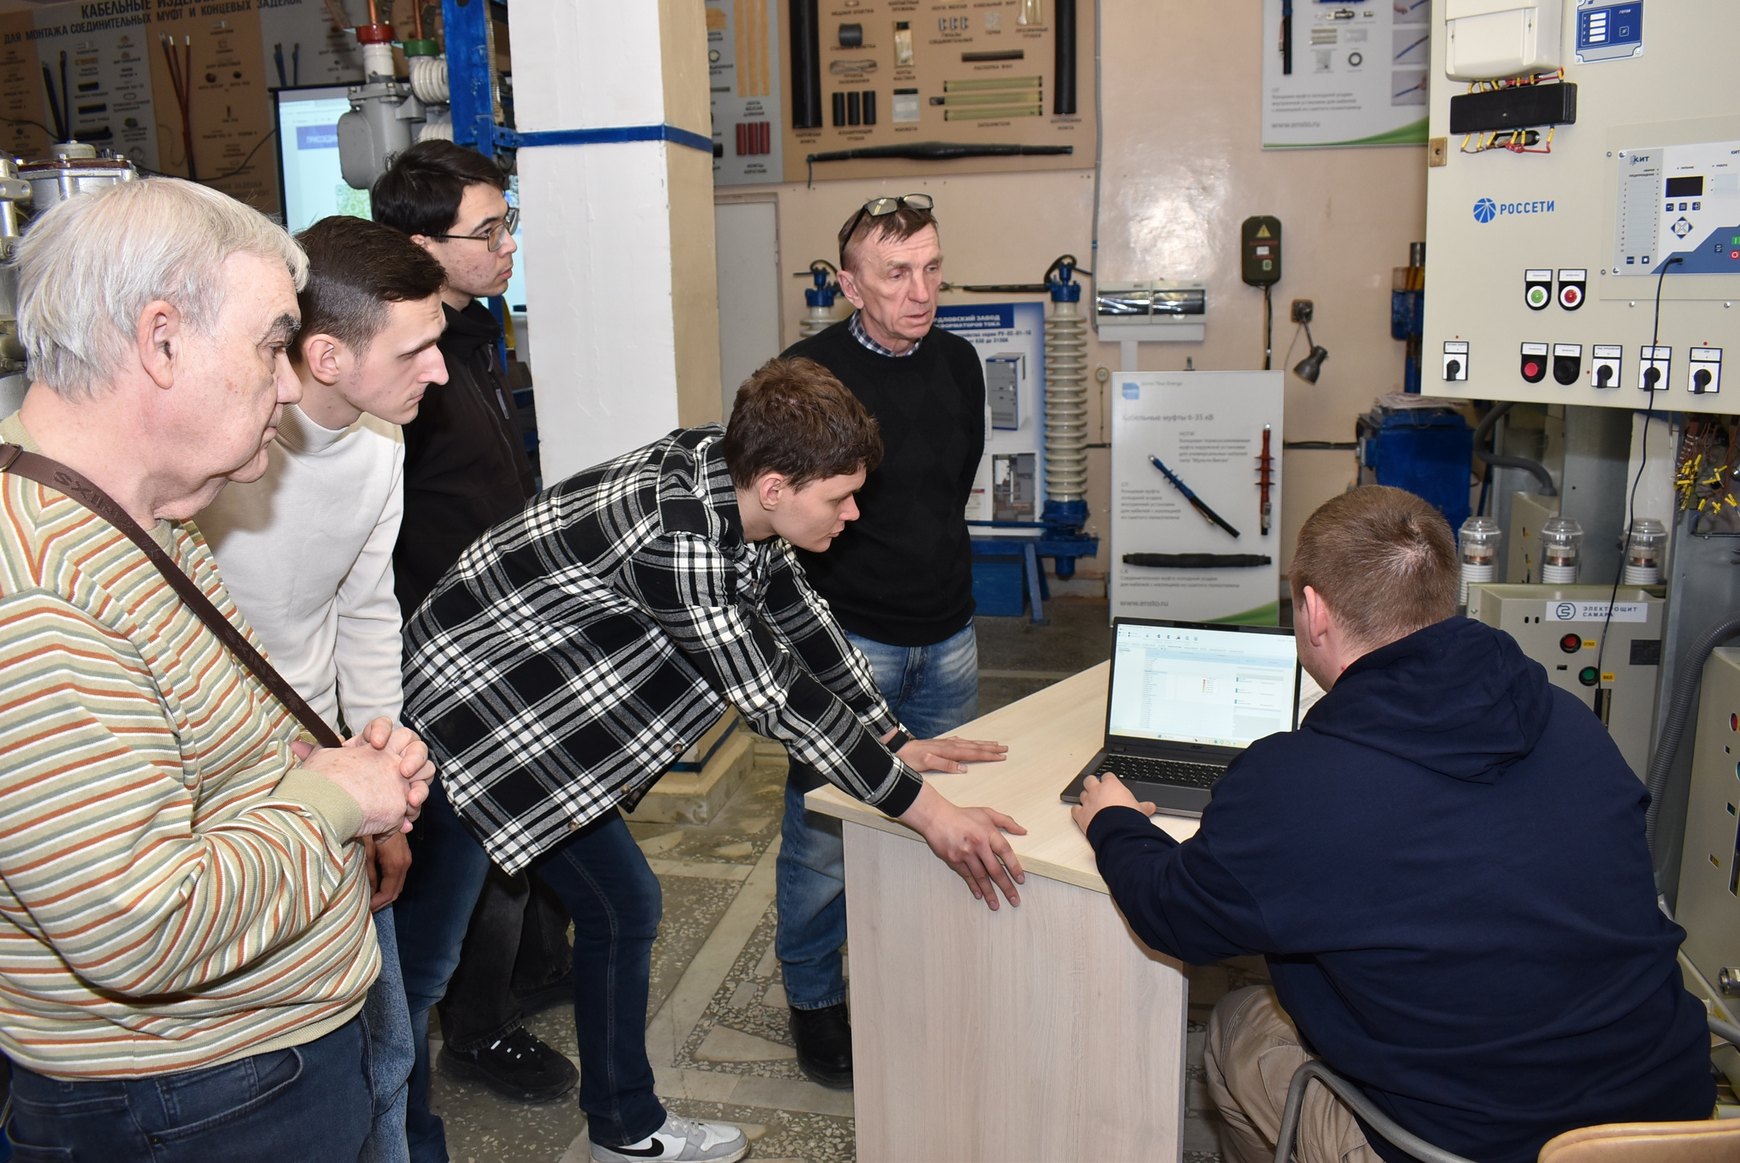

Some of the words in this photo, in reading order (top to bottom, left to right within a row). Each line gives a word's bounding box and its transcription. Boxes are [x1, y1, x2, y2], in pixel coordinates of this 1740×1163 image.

[81, 0, 152, 19] КАБЕЛЬНЫЕ
[4, 32, 22, 45] ДЛЯ
[25, 25, 69, 41] МОНТАЖА
[70, 13, 153, 35] СОЕДИНИТЕЛЬНЫХ
[156, 8, 184, 22] МУФТ
[188, 7, 197, 17] И
[200, 1, 253, 17] КОНЦЕВЫХ
[1500, 200, 1555, 215] РОССЕТИ
